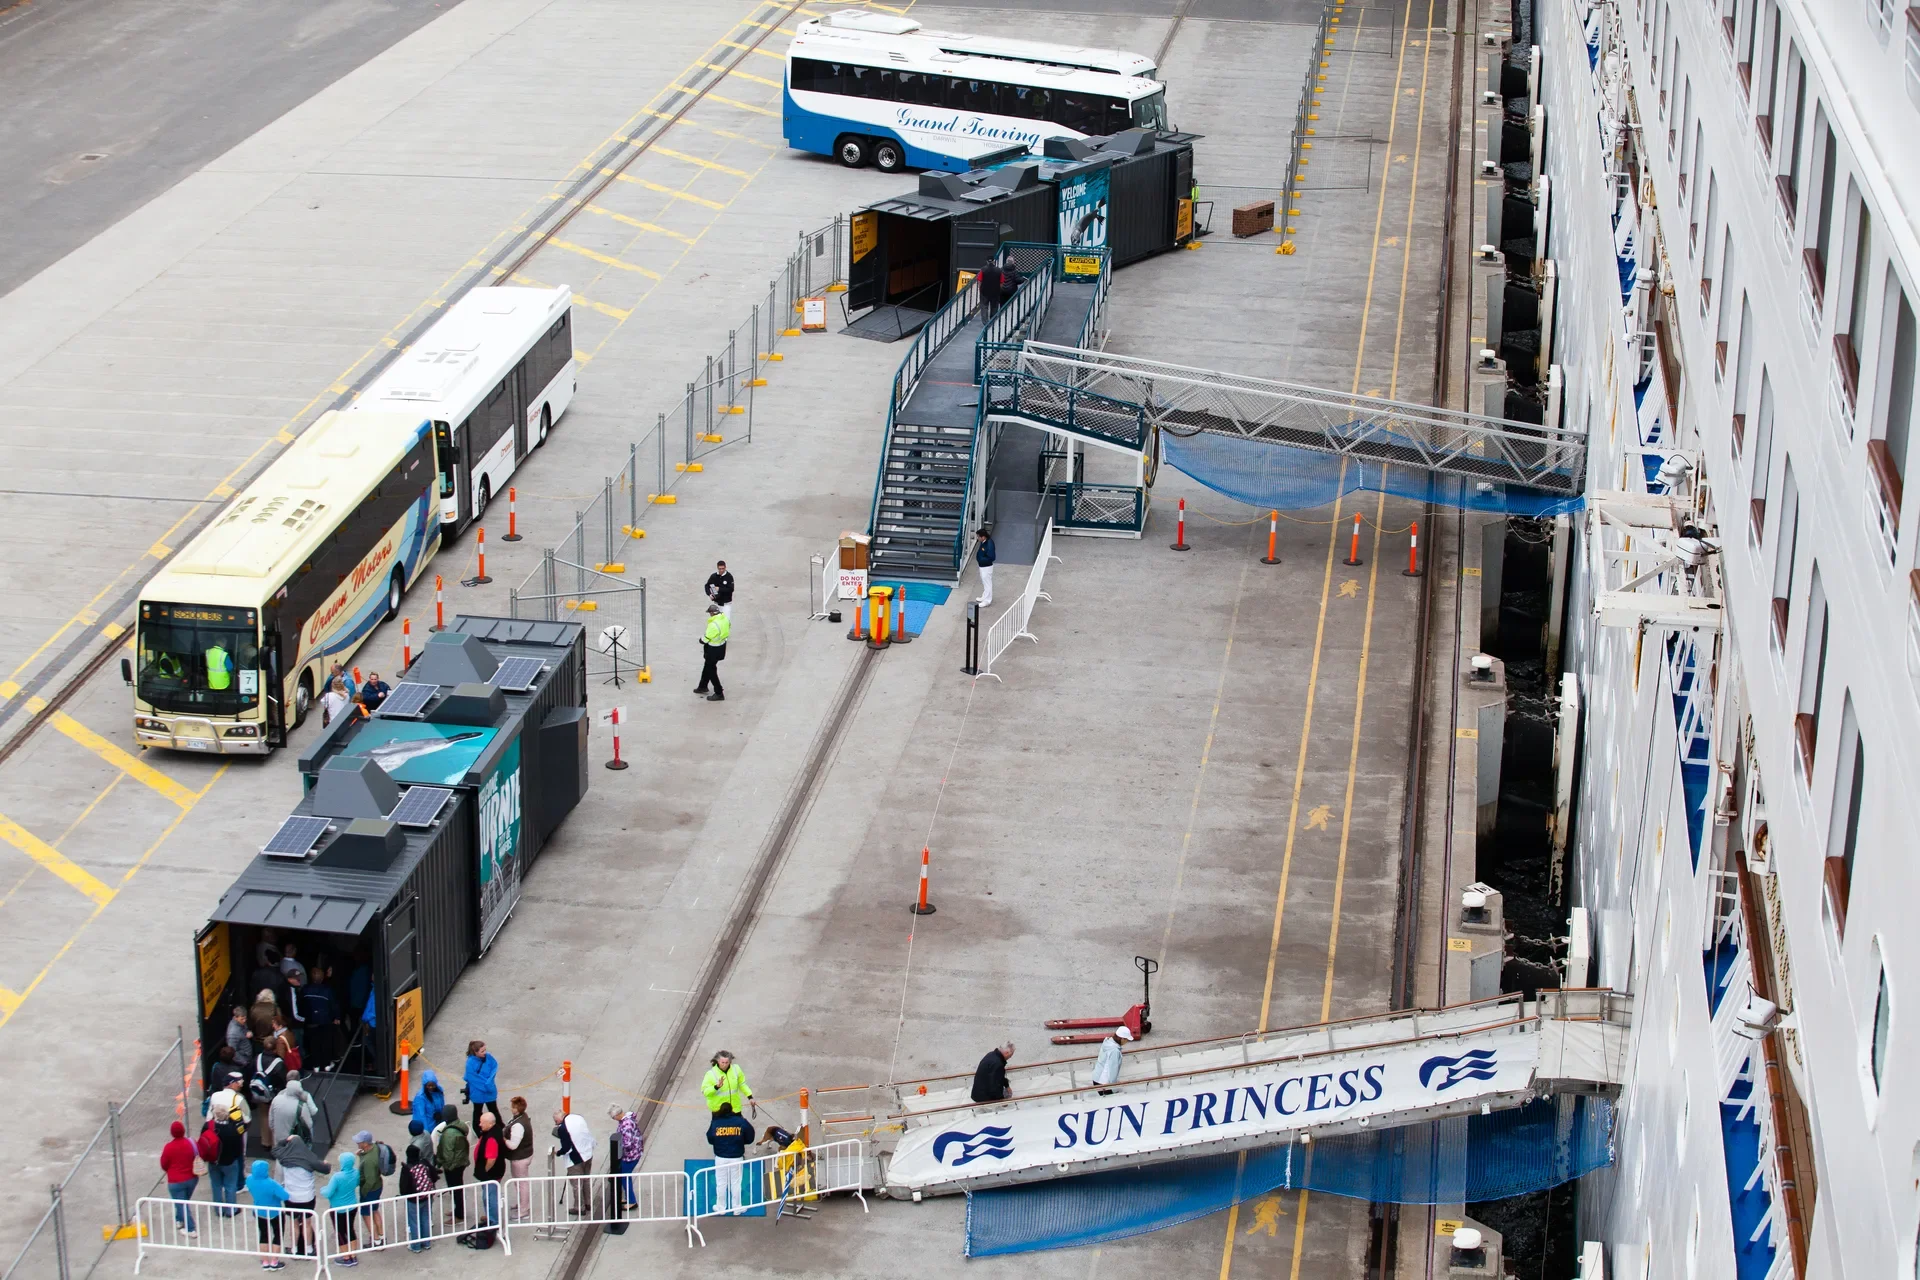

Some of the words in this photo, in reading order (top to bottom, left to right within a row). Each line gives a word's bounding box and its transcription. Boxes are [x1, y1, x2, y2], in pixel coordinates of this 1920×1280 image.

[897, 108, 958, 132] Grand
[962, 117, 1041, 149] Touring
[933, 135, 957, 144] DARWIN
[1061, 182, 1087, 200] WELCOME
[1062, 201, 1068, 210] TO
[1068, 199, 1076, 210] THE
[1059, 201, 1107, 247] WILD
[351, 540, 392, 592] Motors
[173, 610, 206, 620] SCHOOL
[207, 613, 223, 622] BUS
[245, 676, 252, 685] 7
[479, 766, 520, 860] URNIE
[1054, 1101, 1150, 1150] SUN
[1160, 1063, 1386, 1135] PRINCESS
[715, 1126, 742, 1136] SECURITY
